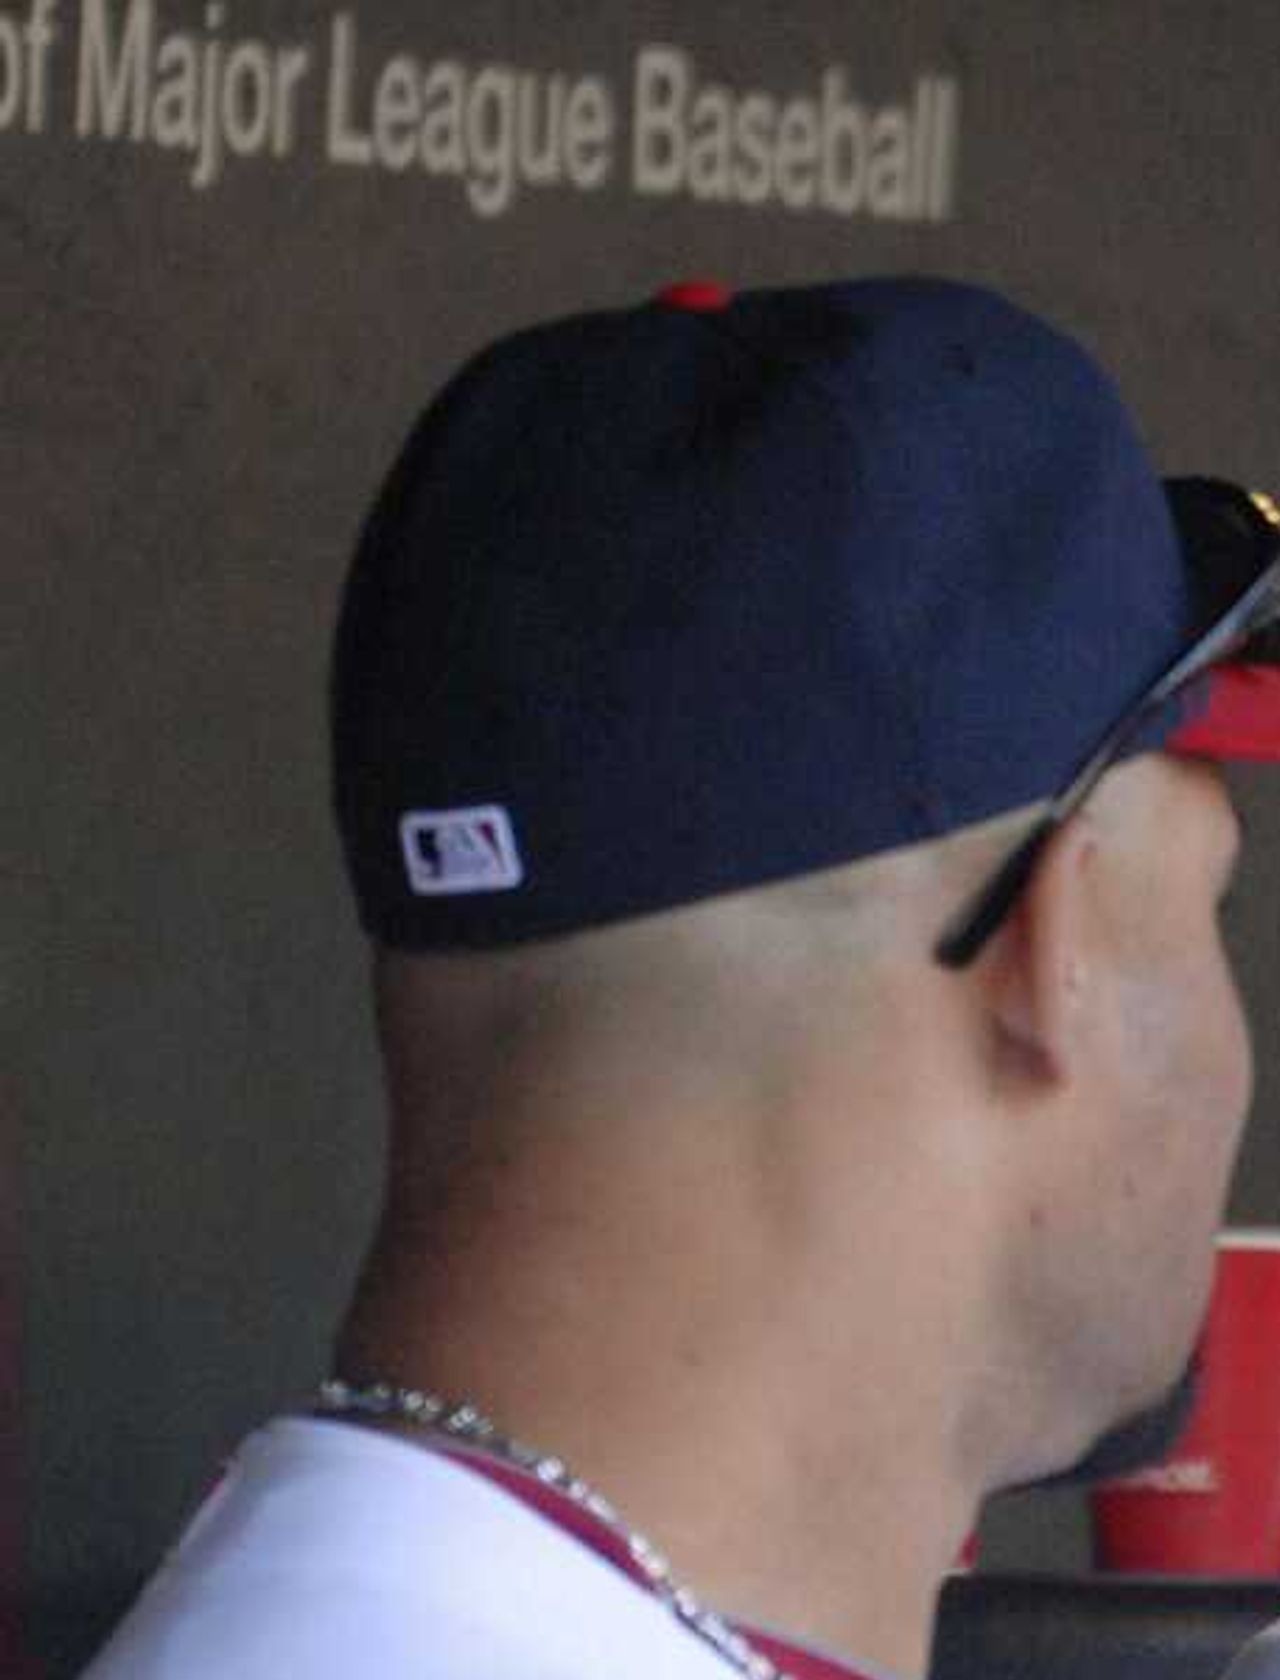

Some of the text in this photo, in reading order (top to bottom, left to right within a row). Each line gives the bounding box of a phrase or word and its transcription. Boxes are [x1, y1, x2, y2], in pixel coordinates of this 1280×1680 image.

[75, 0, 307, 190] Major
[325, 12, 612, 214] League
[630, 44, 958, 222] Baseball
